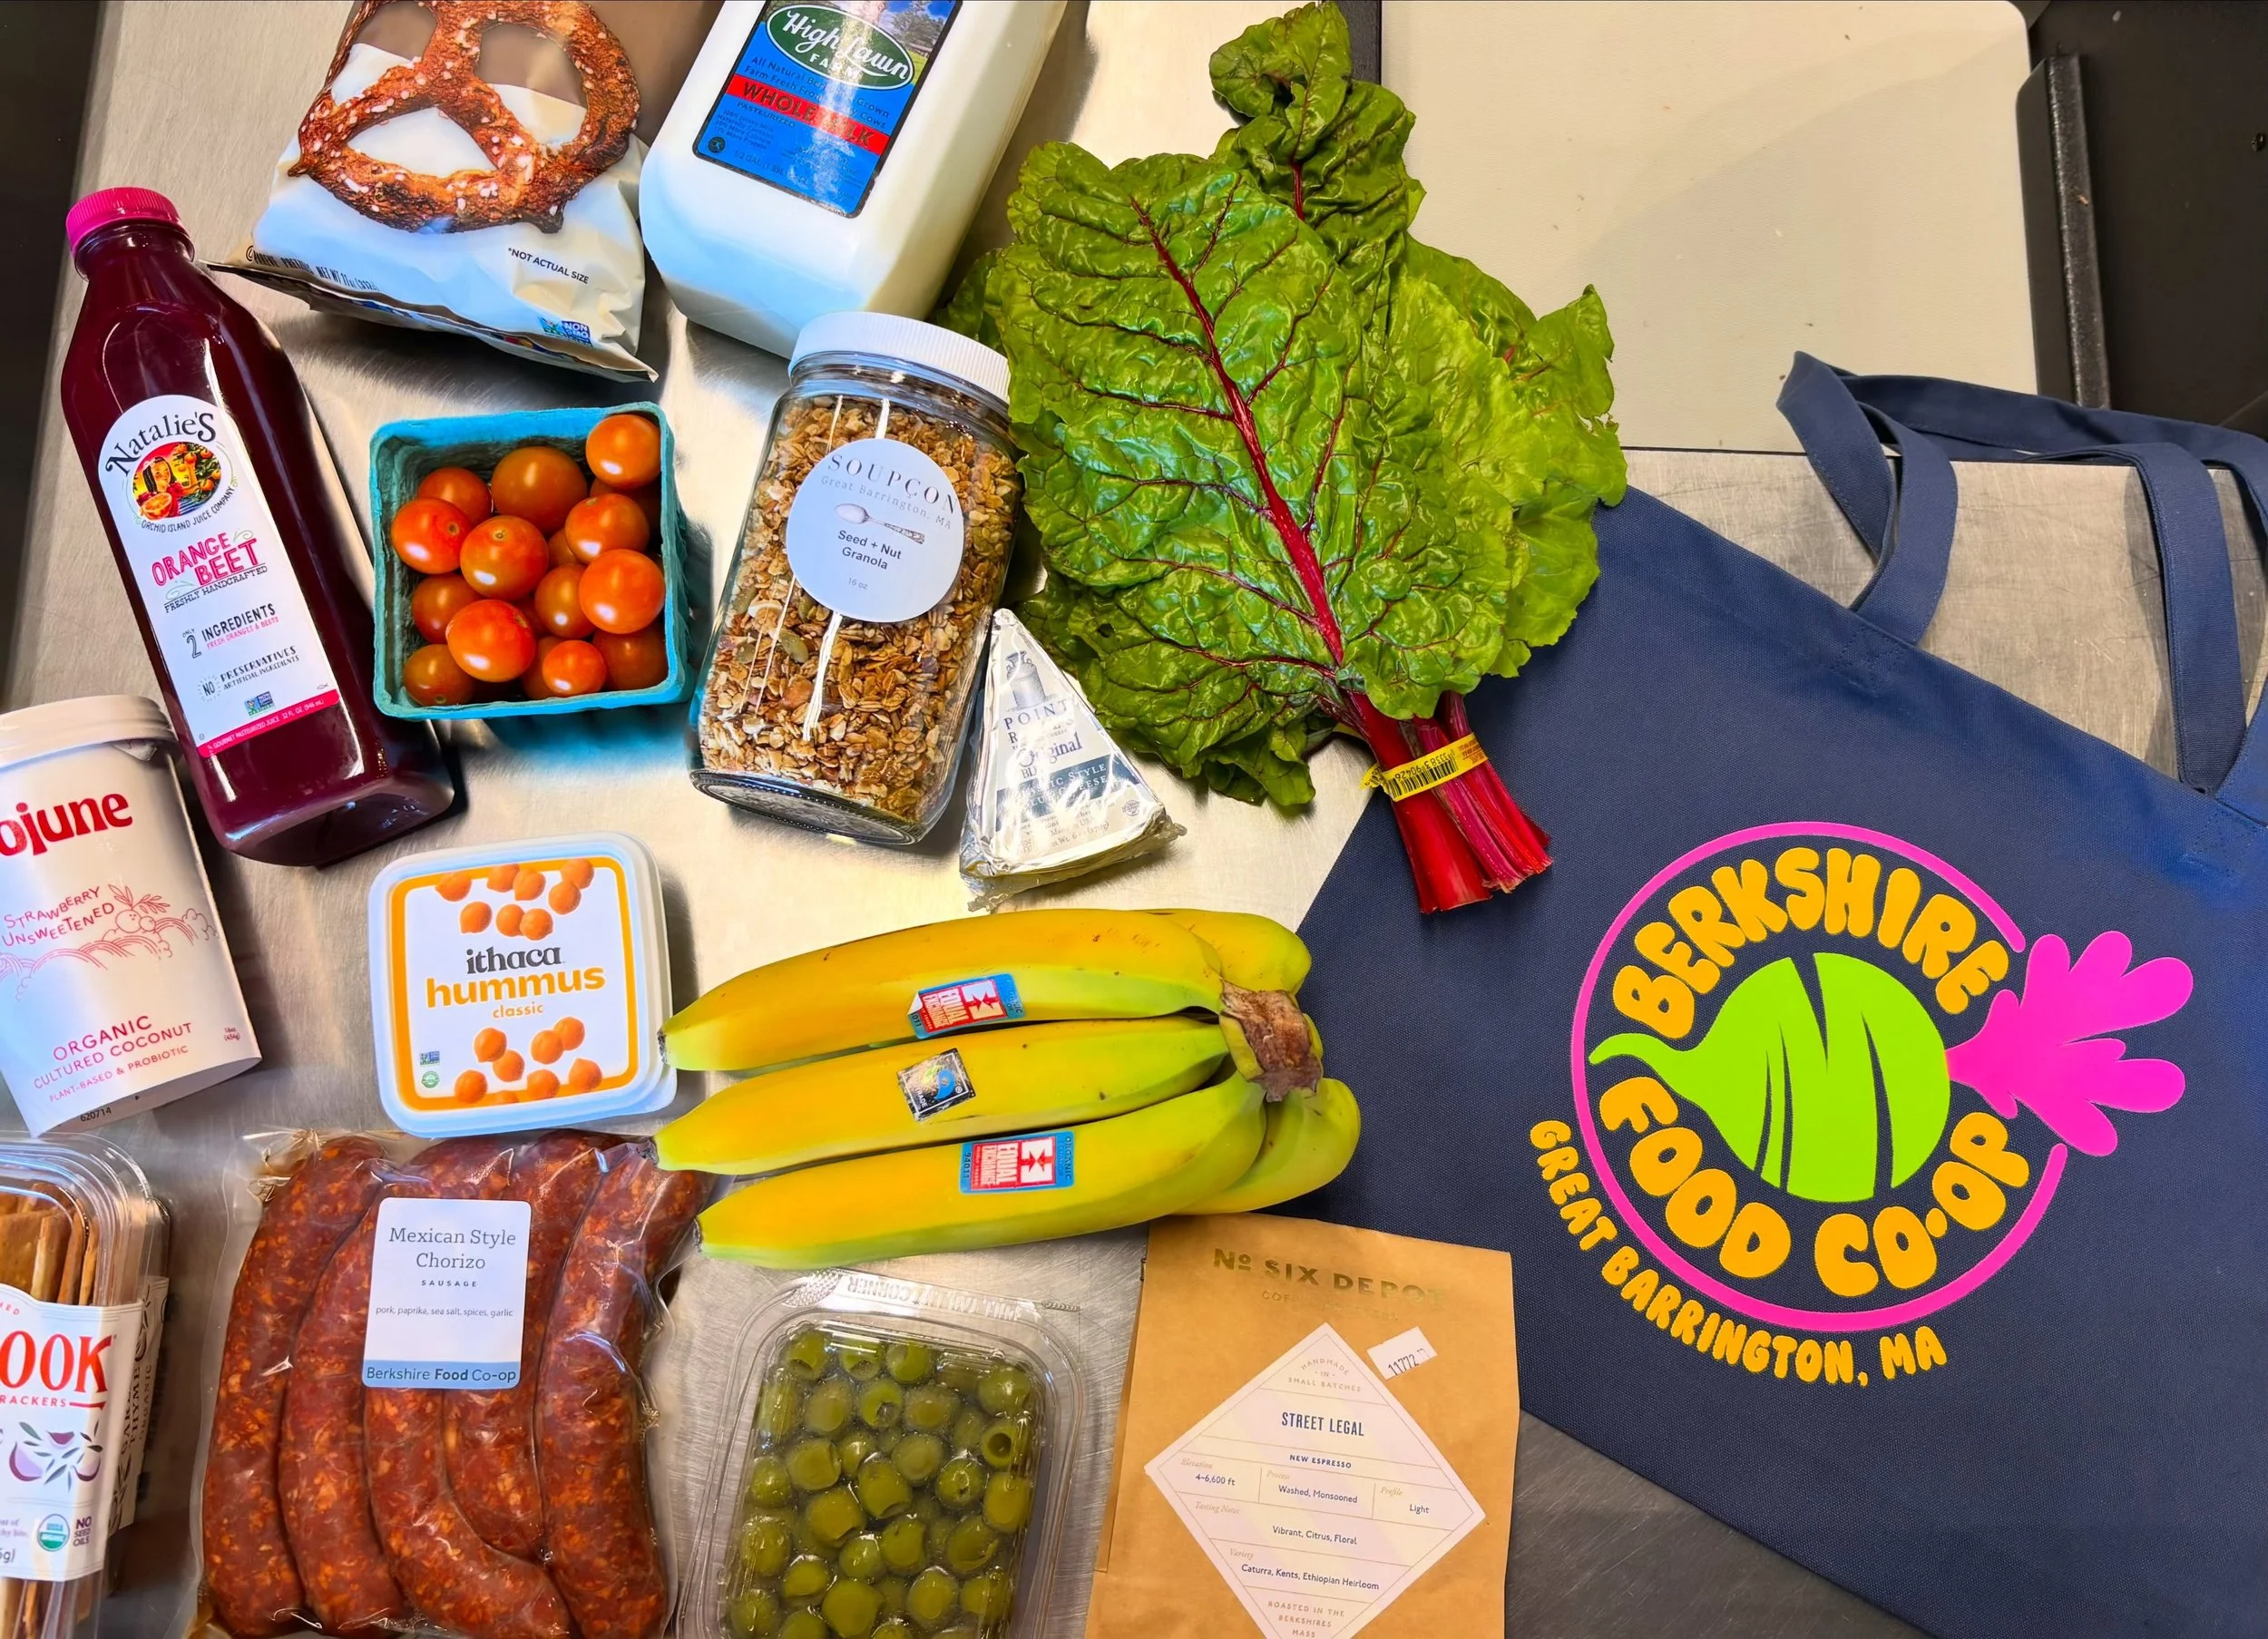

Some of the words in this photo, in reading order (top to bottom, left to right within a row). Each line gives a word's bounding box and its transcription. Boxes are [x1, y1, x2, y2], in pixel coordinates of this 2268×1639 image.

[787, 10, 840, 54] High
[810, 54, 860, 80] FARM
[744, 65, 769, 83] Farm
[771, 74, 797, 93] Fresh
[860, 112, 886, 129] Cows
[751, 56, 767, 66] All
[769, 59, 806, 83] Natural
[857, 98, 889, 118] Grown
[743, 81, 819, 121] WHOLE
[737, 102, 796, 128] PASTEURIZED
[533, 257, 569, 277] ACTUAL
[572, 271, 589, 284] SIZE
[564, 322, 588, 330] NON
[141, 519, 167, 533] ORCHID
[167, 519, 191, 532] ISLAND
[192, 511, 211, 525] JUICE
[210, 487, 235, 515] COMPANY
[821, 475, 854, 491] Great
[859, 484, 931, 520] Barrington,
[935, 516, 952, 530] MA
[837, 531, 867, 547] Seed
[870, 540, 878, 549] +
[881, 544, 902, 560] Nut
[842, 547, 888, 570] Granola
[152, 532, 231, 587] ORANGE
[194, 538, 259, 586] BEET
[163, 590, 200, 613] FRESHLY
[202, 565, 268, 596] HANDCRAFTED
[848, 578, 856, 586] 16
[858, 581, 868, 590] oz
[186, 635, 202, 659] 2
[201, 603, 276, 642] INGREDIENTS
[206, 636, 226, 649] FRESH
[226, 626, 254, 642] ORANGES
[260, 616, 279, 629] BEETS
[203, 681, 215, 697] NO
[220, 645, 297, 681] PRESERVATIVES
[259, 655, 300, 676] INGREDIENTS
[1003, 699, 1070, 730] POINT
[1069, 763, 1107, 781] STYLE
[4, 885, 101, 930] STRAWBERRY
[2, 902, 115, 948] UNSWEETENED
[1612, 846, 2010, 1039] BERKSHIRE
[466, 946, 562, 974] ithaca
[426, 966, 606, 1008] hummus
[493, 1002, 544, 1019] classic
[923, 993, 950, 1029] EXCHANGE
[941, 988, 969, 1026] EQUAL
[53, 1015, 152, 1061] ORGANIC
[34, 1052, 104, 1089] CULTURED
[110, 1022, 193, 1058] COCONUT
[49, 1069, 112, 1102] PLANT-BASED
[115, 1065, 125, 1075] &
[128, 1045, 189, 1070] PROBIOTIC
[80, 1107, 112, 1123] 620714
[982, 1145, 999, 1186] EXCHANGE
[999, 1143, 1019, 1186] EQUAL
[1598, 1075, 1793, 1279] FOOD
[388, 1227, 465, 1244] Mexican
[470, 1229, 516, 1249] Style
[416, 1253, 485, 1269] Chorizo
[1529, 1119, 1616, 1252] GREAT
[1601, 1244, 1870, 1388] BARRINGTON,
[1878, 1325, 1949, 1375] MA
[847, 1276, 910, 1301] CORNER
[1265, 1259, 1319, 1285] SIX
[1334, 1272, 1446, 1304] DEPOT
[376, 1306, 396, 1314] pork,
[397, 1307, 430, 1315] paprika,
[464, 1309, 489, 1317] spices,
[490, 1309, 513, 1318] garlic
[367, 1367, 430, 1380] Berkshire
[435, 1369, 468, 1380] Food
[472, 1370, 516, 1383] Co-op
[1300, 1358, 1350, 1376] HANDMADE
[1288, 1377, 1316, 1386] SMALL
[1321, 1381, 1362, 1392] BATCHES
[1281, 1411, 1325, 1433] STREET
[1329, 1417, 1365, 1438] LEGAL
[1180, 1457, 1214, 1470] Elevation
[1266, 1469, 1291, 1480] Process
[1289, 1454, 1309, 1464] NEW
[1311, 1457, 1352, 1470] ESPRESSO
[1227, 1477, 1236, 1487] ft
[1278, 1484, 1311, 1498] Washed,
[1312, 1488, 1358, 1504] Monsooned
[1380, 1485, 1403, 1498] Profile
[1195, 1500, 1218, 1514] Tasting
[1220, 1505, 1241, 1515] Notes
[1409, 1503, 1430, 1516] Light
[74, 1528, 91, 1537] SEED
[76, 1517, 92, 1529] NO
[1272, 1526, 1304, 1538] Vibrant,
[1305, 1529, 1333, 1544] Citrus,
[1334, 1534, 1357, 1546] Floral
[73, 1536, 89, 1546] OILS
[1228, 1547, 1255, 1561] Variety
[1241, 1563, 1274, 1578] Caturra,
[1276, 1569, 1301, 1582] Kents,
[1303, 1572, 1342, 1587] Ethiopian
[1343, 1579, 1380, 1591] Heirloom
[1267, 1600, 1311, 1613] ROASTED
[1314, 1605, 1324, 1615] IN
[1326, 1608, 1344, 1618] THE
[1278, 1615, 1332, 1629] BERKSHIRES
[1292, 1628, 1315, 1638] MASS
